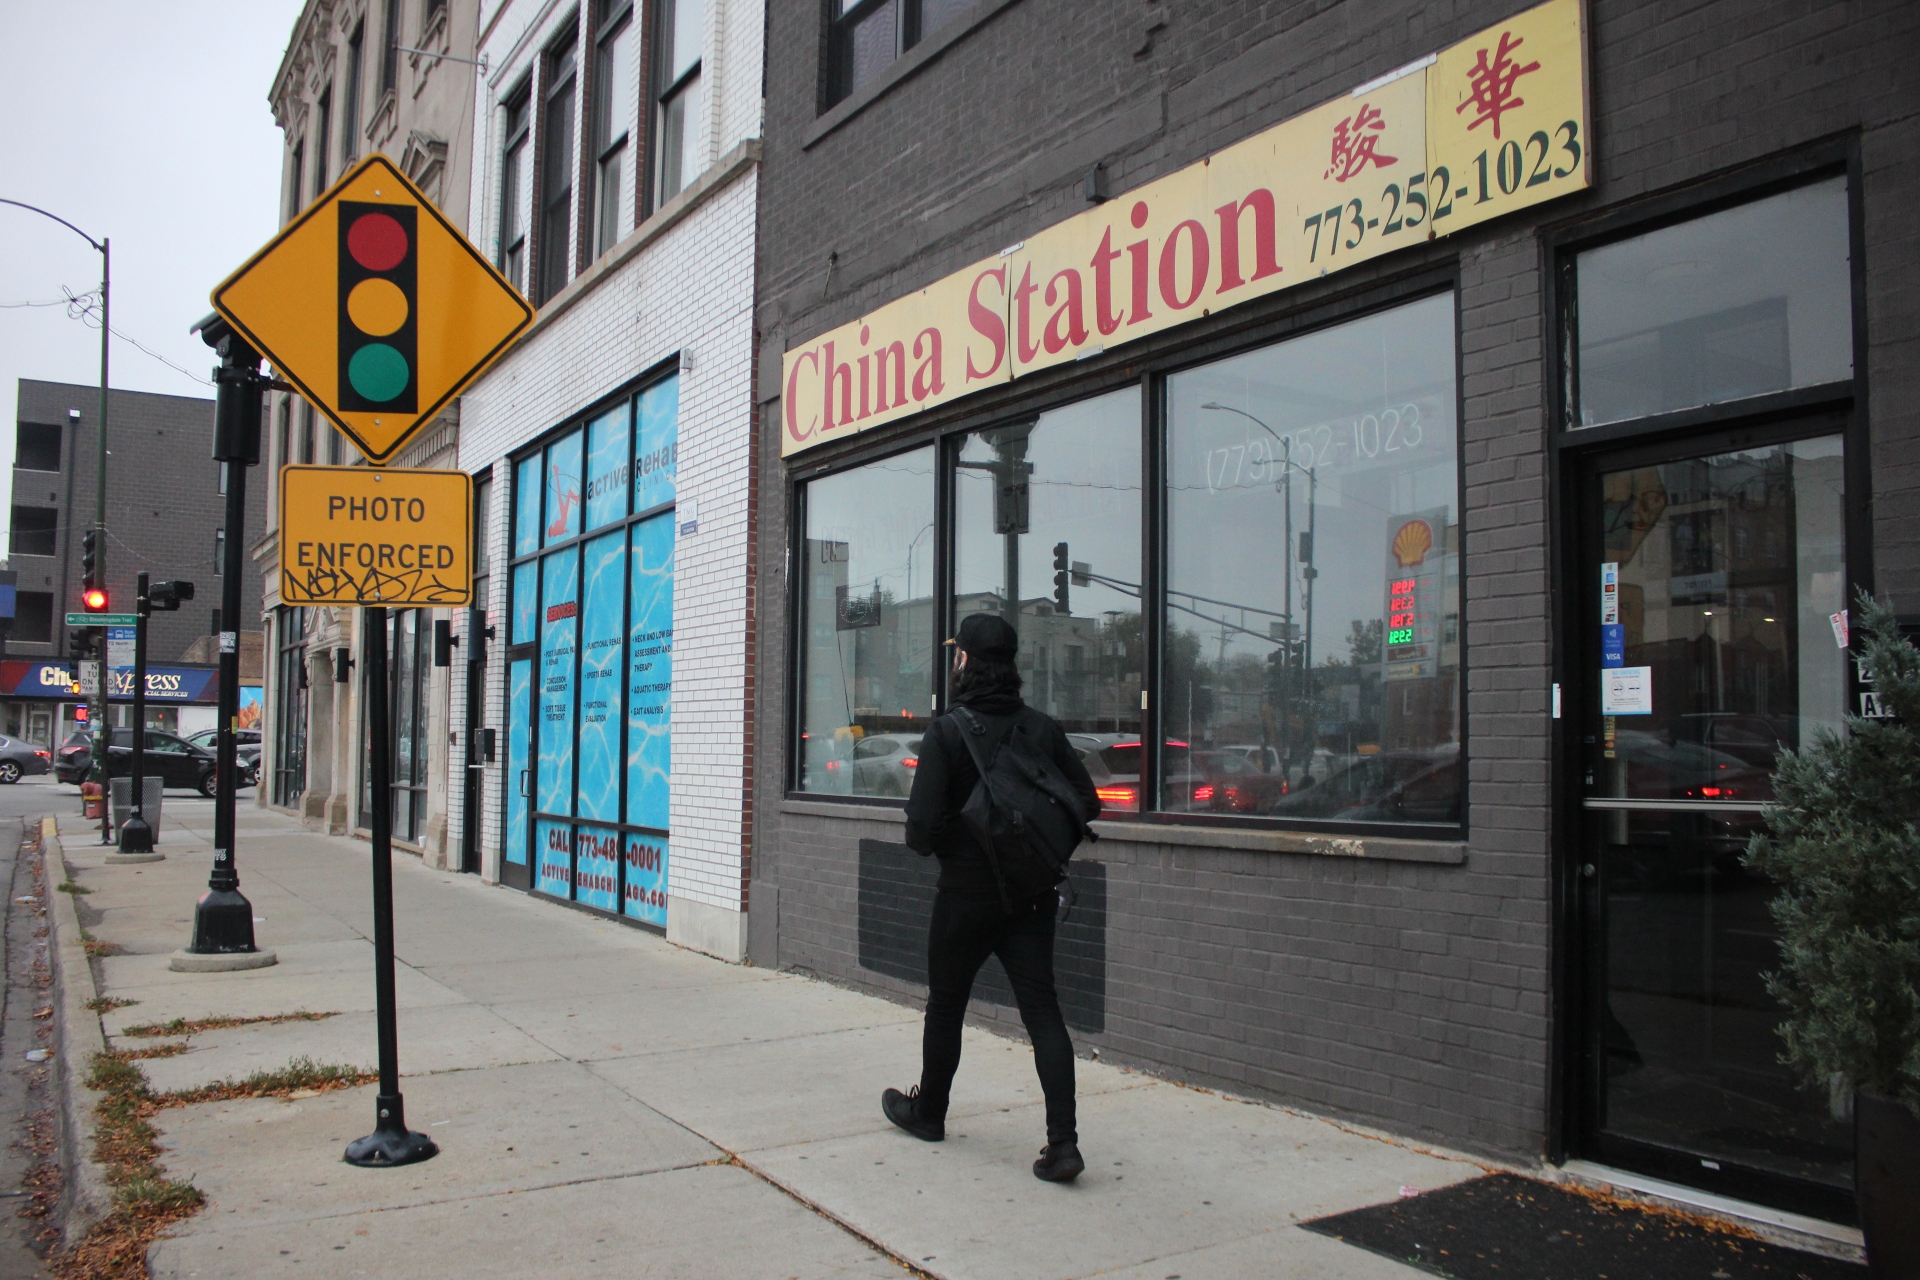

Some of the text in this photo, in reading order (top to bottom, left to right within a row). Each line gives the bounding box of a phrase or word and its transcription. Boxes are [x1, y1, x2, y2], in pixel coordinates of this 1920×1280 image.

[1303, 120, 1582, 264] 773-252-1023
[785, 187, 1284, 443] China Station
[328, 495, 425, 523] PHOTO
[297, 541, 455, 570] ENFORCED
[89, 616, 121, 624] Bloomingdale
[635, 633, 646, 643] NECK
[647, 631, 655, 640] AND
[656, 630, 665, 639] LOW
[587, 637, 622, 650] FUNCTIONAL REHAB
[634, 644, 671, 657] ASSESSMENT AND
[1606, 653, 1621, 661] VISA
[634, 662, 652, 672] THERAPY
[586, 669, 612, 679] SPORTS REHAB
[634, 682, 672, 694] AQUATIC THERAPY
[545, 704, 566, 713] SOFT TISSUE
[586, 701, 607, 709] FUNCTIONAL
[633, 705, 664, 715] GAIT ANALYSIS
[578, 833, 661, 874] 773-48-0001
[541, 862, 668, 911] ACTIVEEHABCHIAGO.CO
